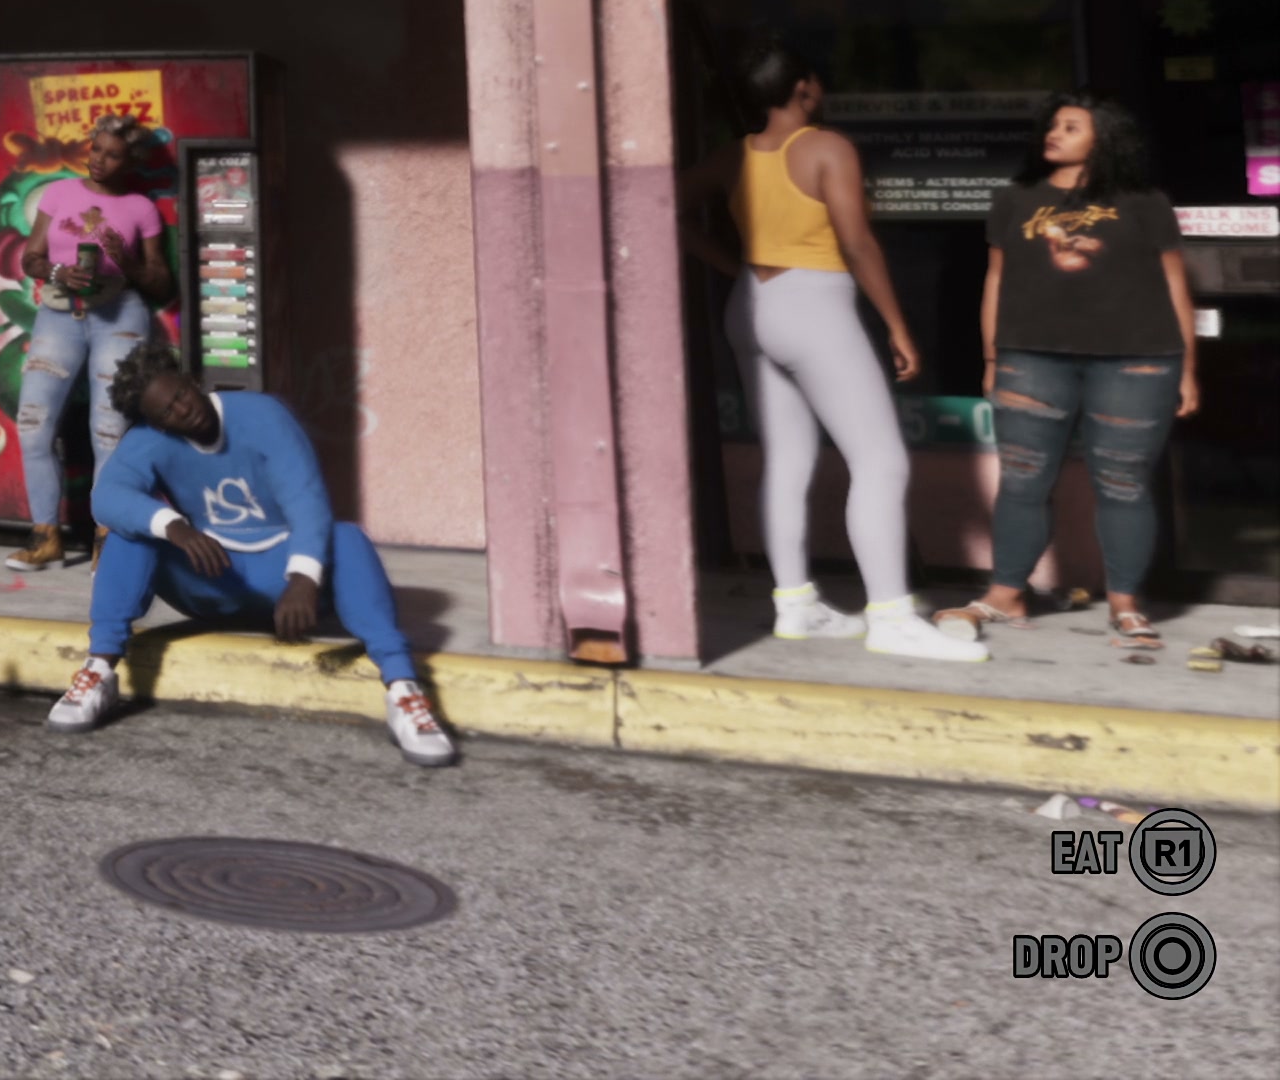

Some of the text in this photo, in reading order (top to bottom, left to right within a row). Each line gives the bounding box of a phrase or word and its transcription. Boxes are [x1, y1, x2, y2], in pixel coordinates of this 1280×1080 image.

[44, 84, 120, 105] SPREAD
[45, 108, 81, 126] THE
[917, 132, 1032, 143] MAINTENANC
[876, 177, 914, 187] HEMS
[926, 177, 1012, 187] ALTERATION
[875, 189, 992, 199] COSTUMES MADE
[1177, 209, 1230, 219] WALK
[1180, 222, 1272, 233] WELCOME
